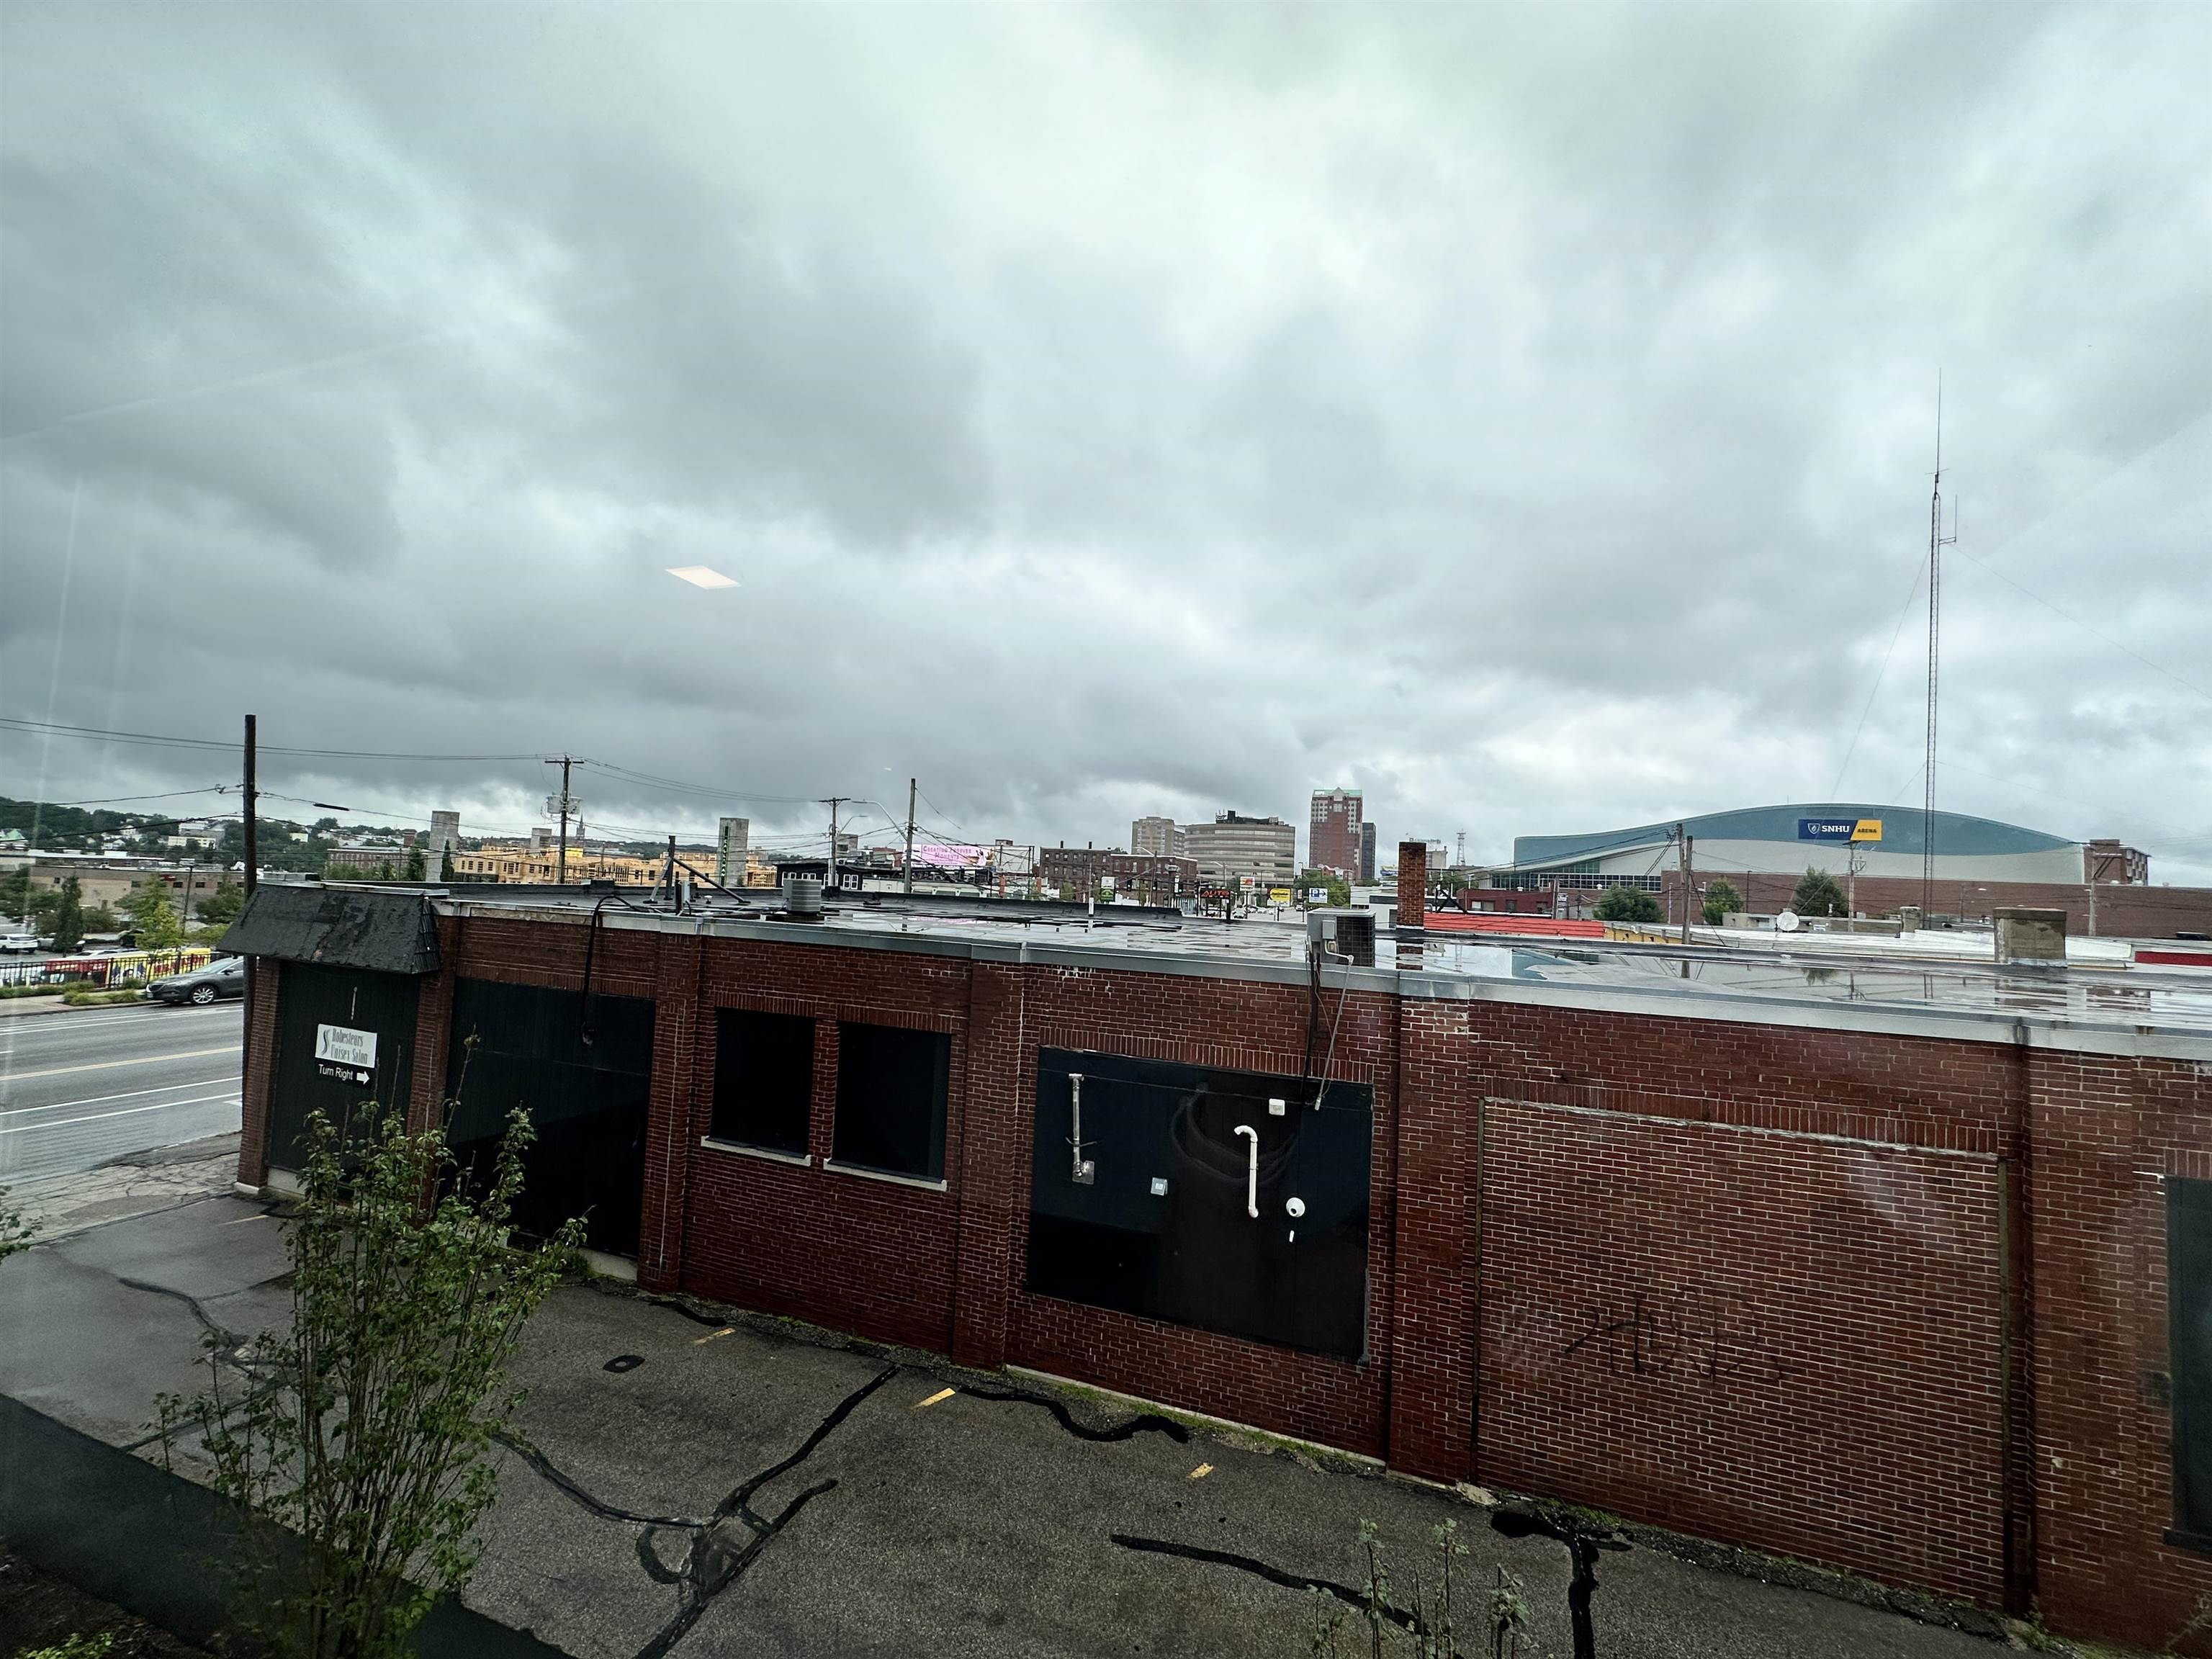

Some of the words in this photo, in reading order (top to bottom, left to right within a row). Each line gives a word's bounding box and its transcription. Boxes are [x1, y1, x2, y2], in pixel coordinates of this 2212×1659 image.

[352, 1048, 368, 1064] Salon
[318, 1064, 334, 1076] Turn
[335, 1067, 354, 1081] Right
